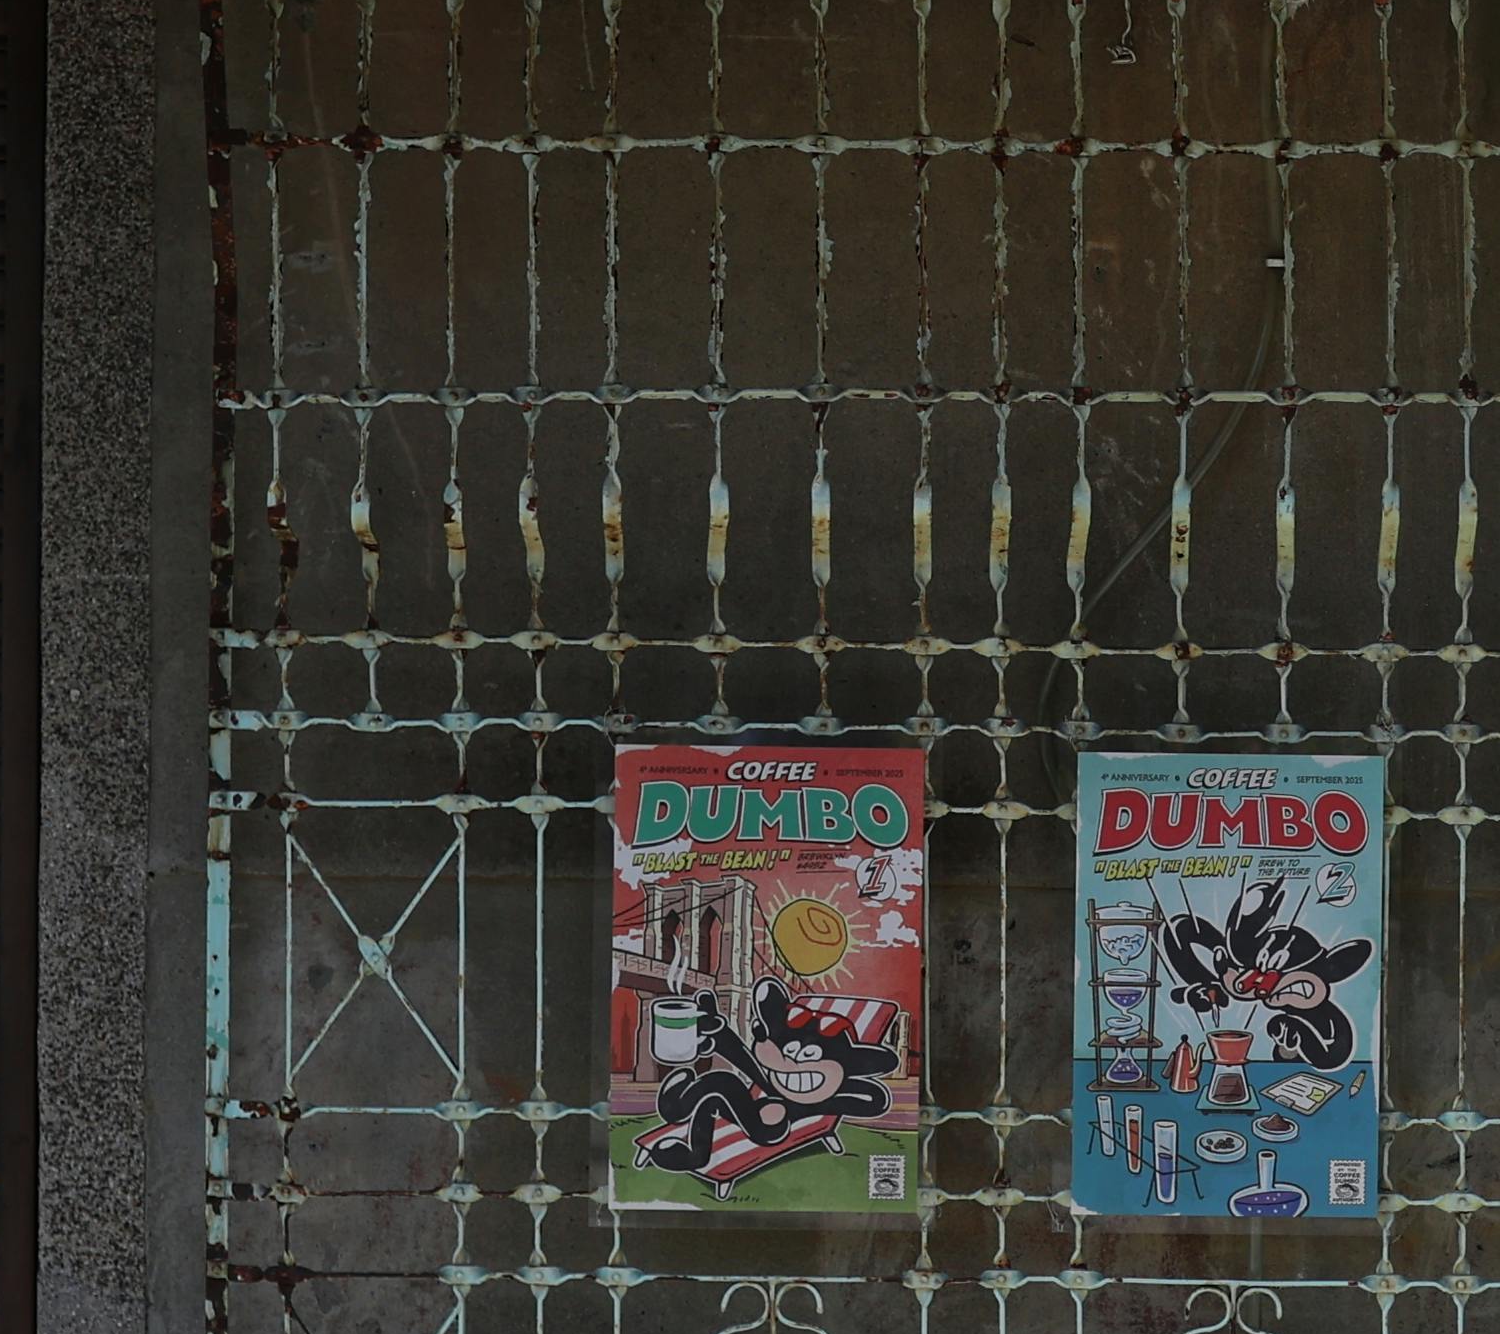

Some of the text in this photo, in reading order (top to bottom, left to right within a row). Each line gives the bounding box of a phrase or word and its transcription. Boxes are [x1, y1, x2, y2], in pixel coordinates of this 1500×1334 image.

[726, 760, 817, 783] COFFEE
[836, 769, 883, 778] SEPTEMBER
[1111, 773, 1169, 781] ANNIVERSARY
[1186, 768, 1278, 790] COFFEE
[1296, 776, 1343, 784] SEPTEMBER
[630, 781, 910, 849] DUMBO
[1093, 788, 1370, 856] DUMBO
[699, 853, 720, 866] THE
[1258, 859, 1284, 867] BREW
[1161, 860, 1180, 873] THE
[1258, 867, 1311, 876] THE FUTURE
[862, 855, 892, 896] 1
[1318, 862, 1355, 904] 2
